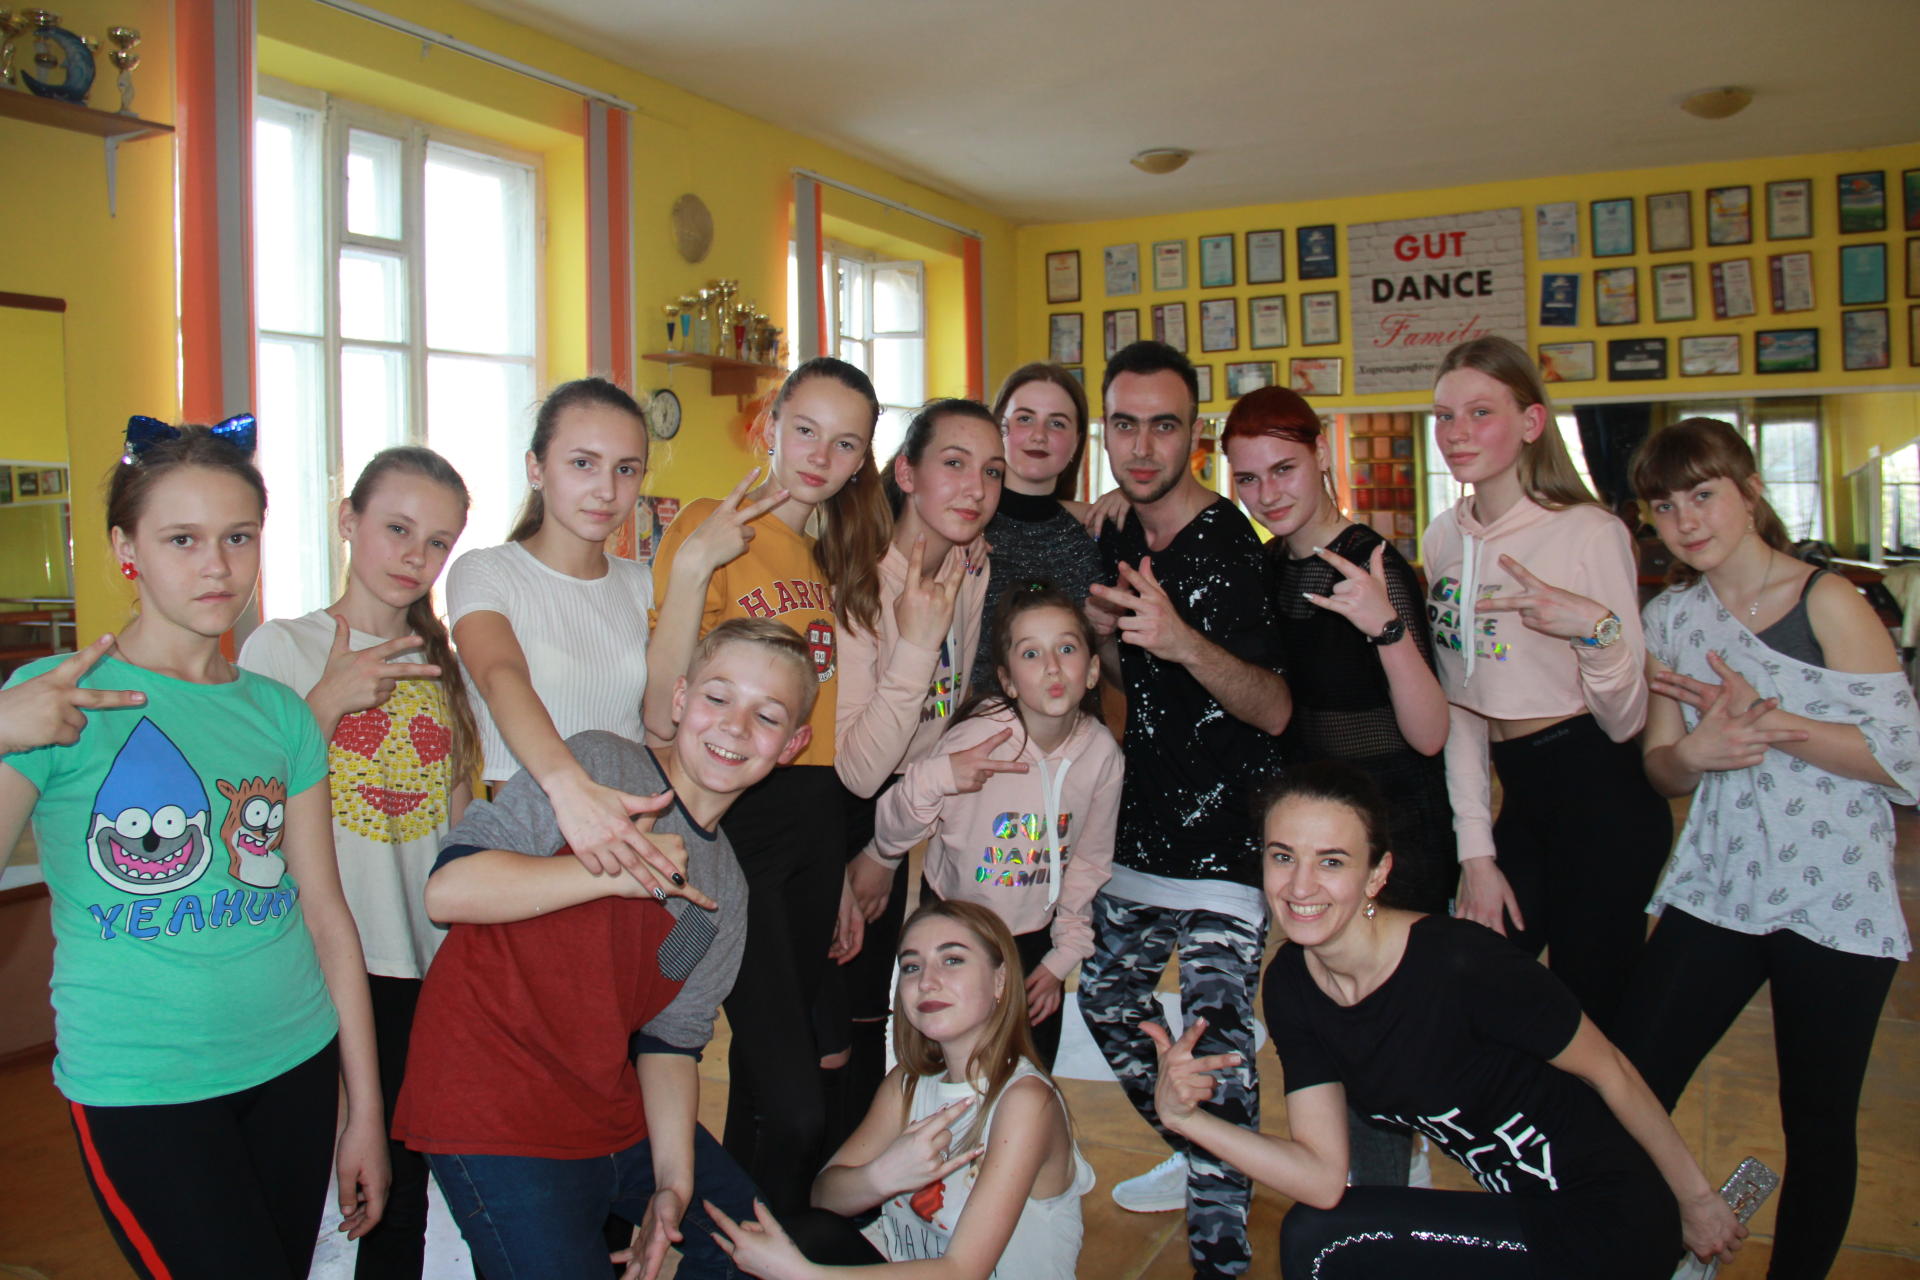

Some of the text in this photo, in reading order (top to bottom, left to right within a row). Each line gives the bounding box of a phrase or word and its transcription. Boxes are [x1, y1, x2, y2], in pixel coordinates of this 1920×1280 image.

[1394, 231, 1467, 262] GUT
[1371, 270, 1493, 304] DANCE
[738, 579, 834, 618] HARV
